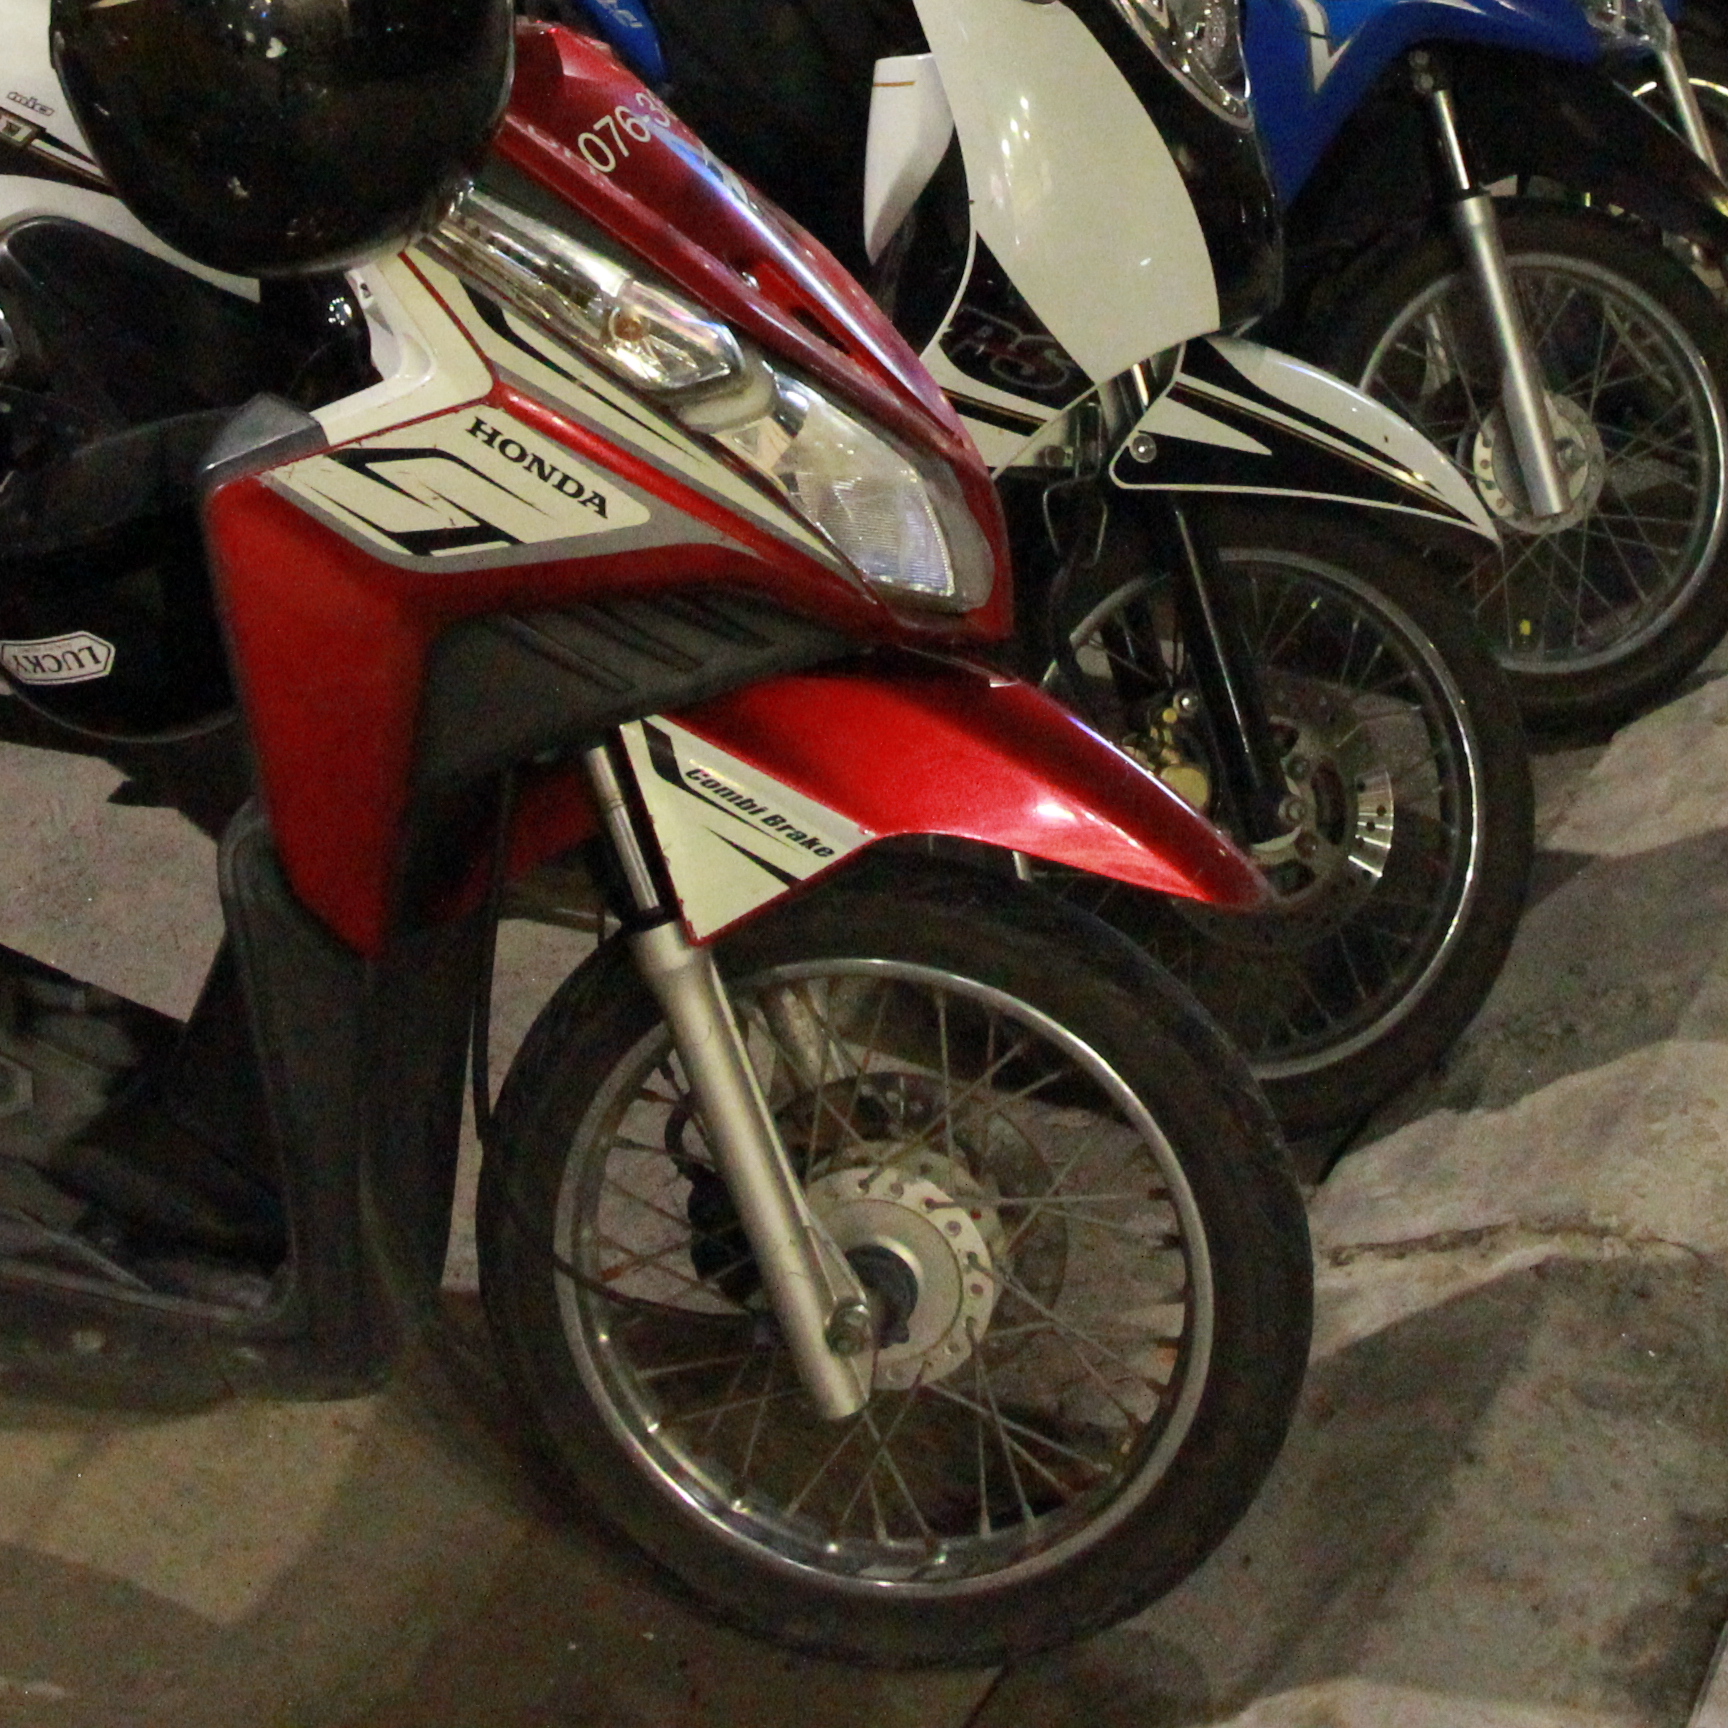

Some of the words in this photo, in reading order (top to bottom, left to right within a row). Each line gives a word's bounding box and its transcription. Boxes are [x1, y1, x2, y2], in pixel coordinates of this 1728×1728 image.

[465, 415, 609, 520] HONDA
[12, 645, 103, 674] LUCKY
[685, 767, 769, 816] Combi
[760, 813, 836, 858] Brake
